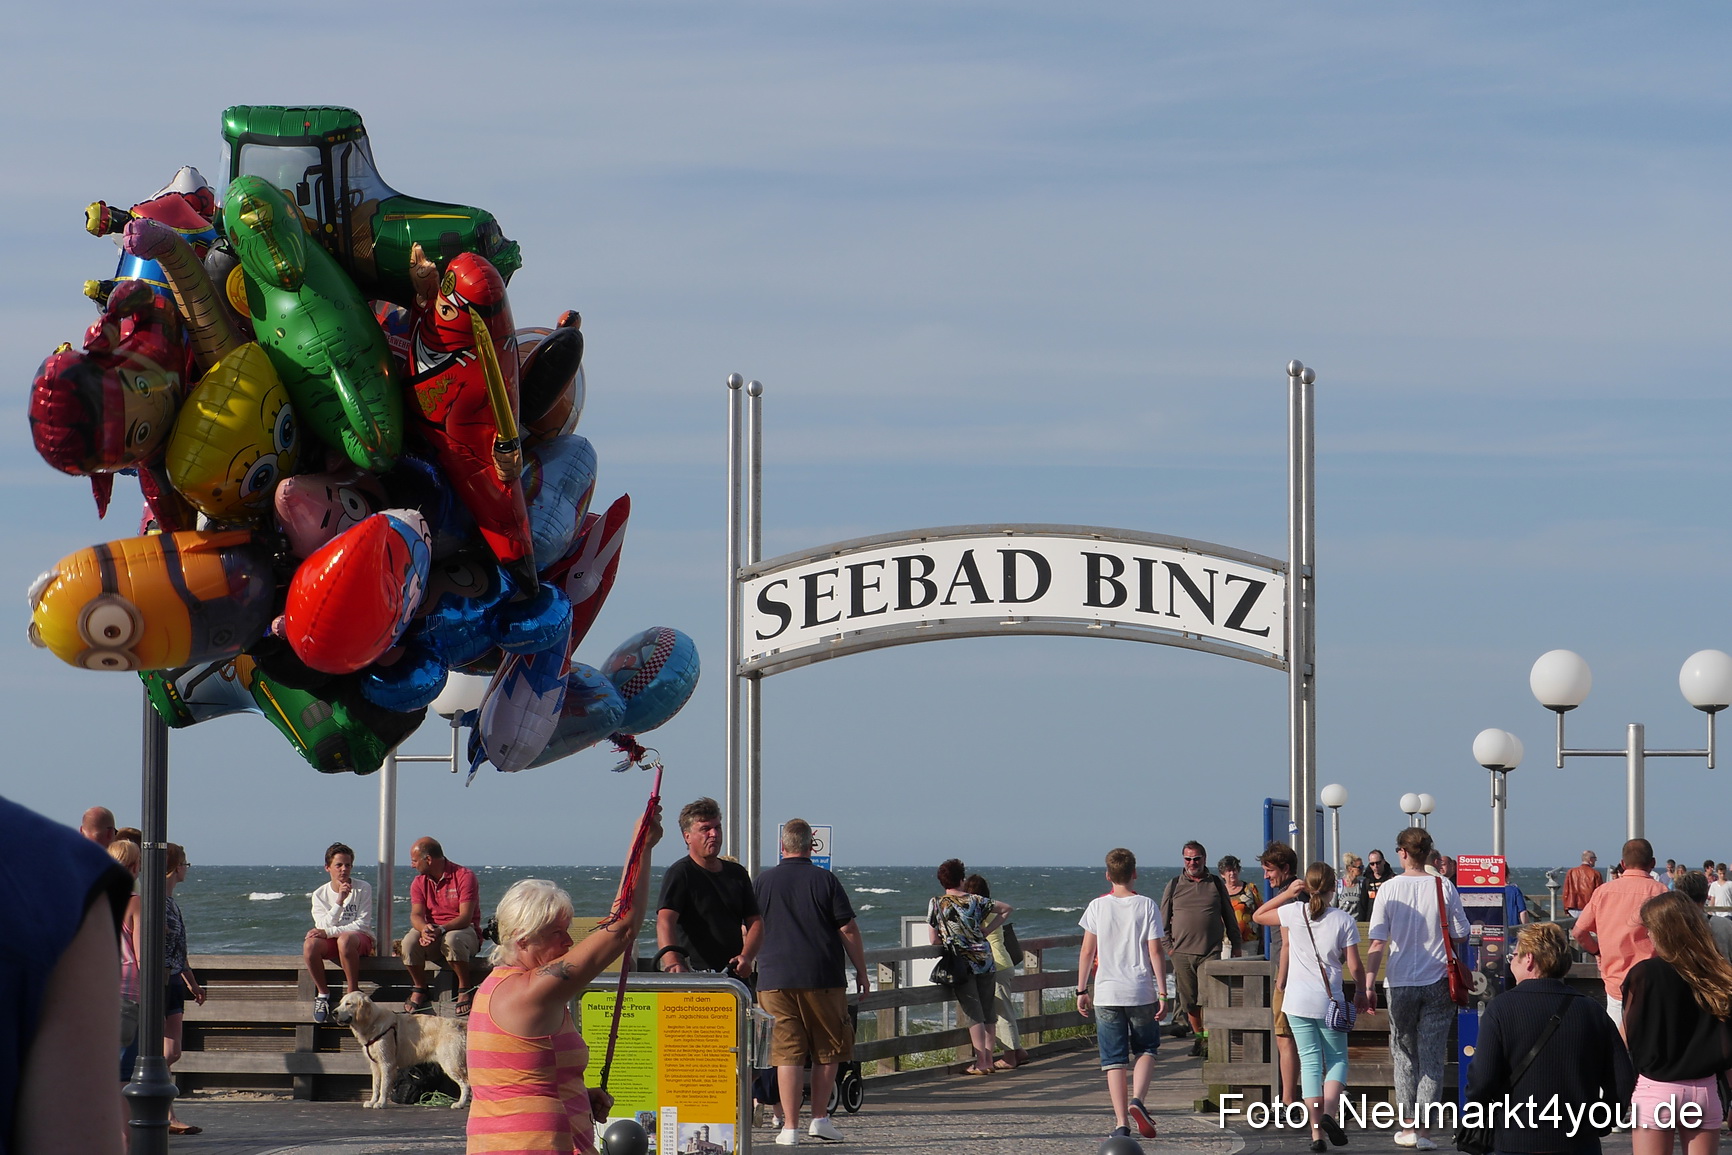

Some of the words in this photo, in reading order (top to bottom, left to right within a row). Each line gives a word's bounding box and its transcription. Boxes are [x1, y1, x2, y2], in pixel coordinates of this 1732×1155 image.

[754, 549, 1053, 640] SEEBAD
[1080, 551, 1270, 638] BINZ
[1459, 855, 1504, 864] Souvenirs
[662, 1004, 733, 1013] Jagdschlossexpress
